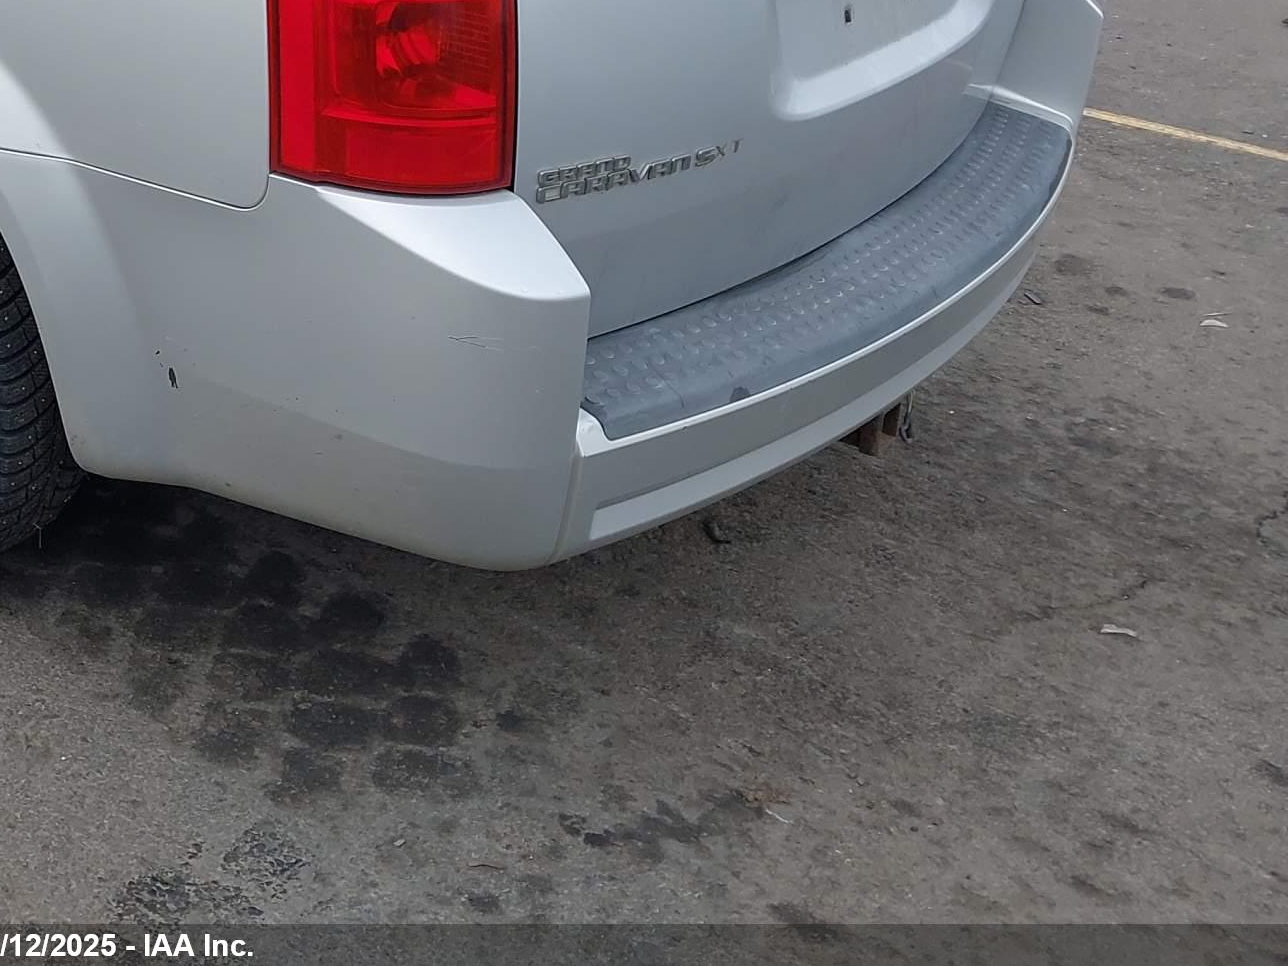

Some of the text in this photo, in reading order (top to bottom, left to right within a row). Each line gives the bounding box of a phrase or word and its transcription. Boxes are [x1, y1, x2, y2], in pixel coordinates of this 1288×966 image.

[535, 137, 745, 204] CARAVAN SXT
[537, 154, 632, 186] GRAND
